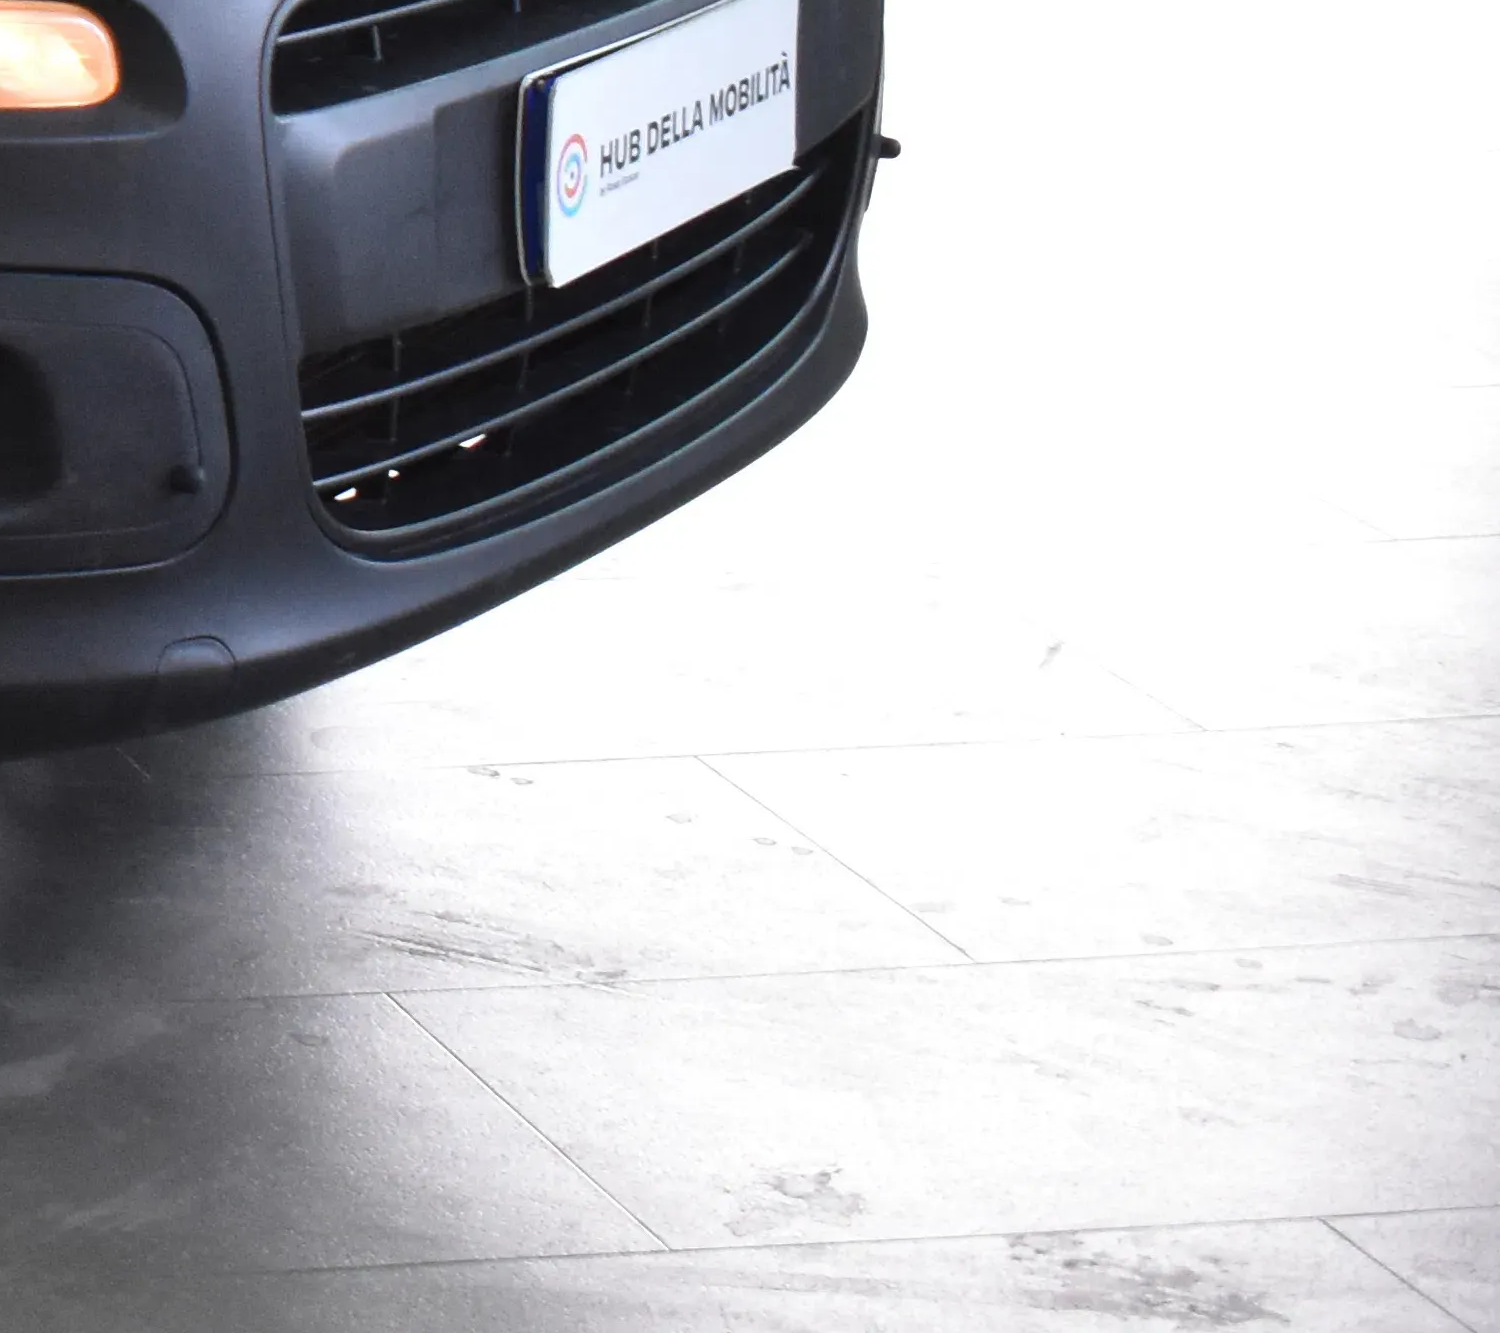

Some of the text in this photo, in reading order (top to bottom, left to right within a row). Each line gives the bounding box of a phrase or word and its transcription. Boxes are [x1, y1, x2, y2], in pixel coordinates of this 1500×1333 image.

[599, 50, 791, 178] HUB DELLA MOBILITÀ
